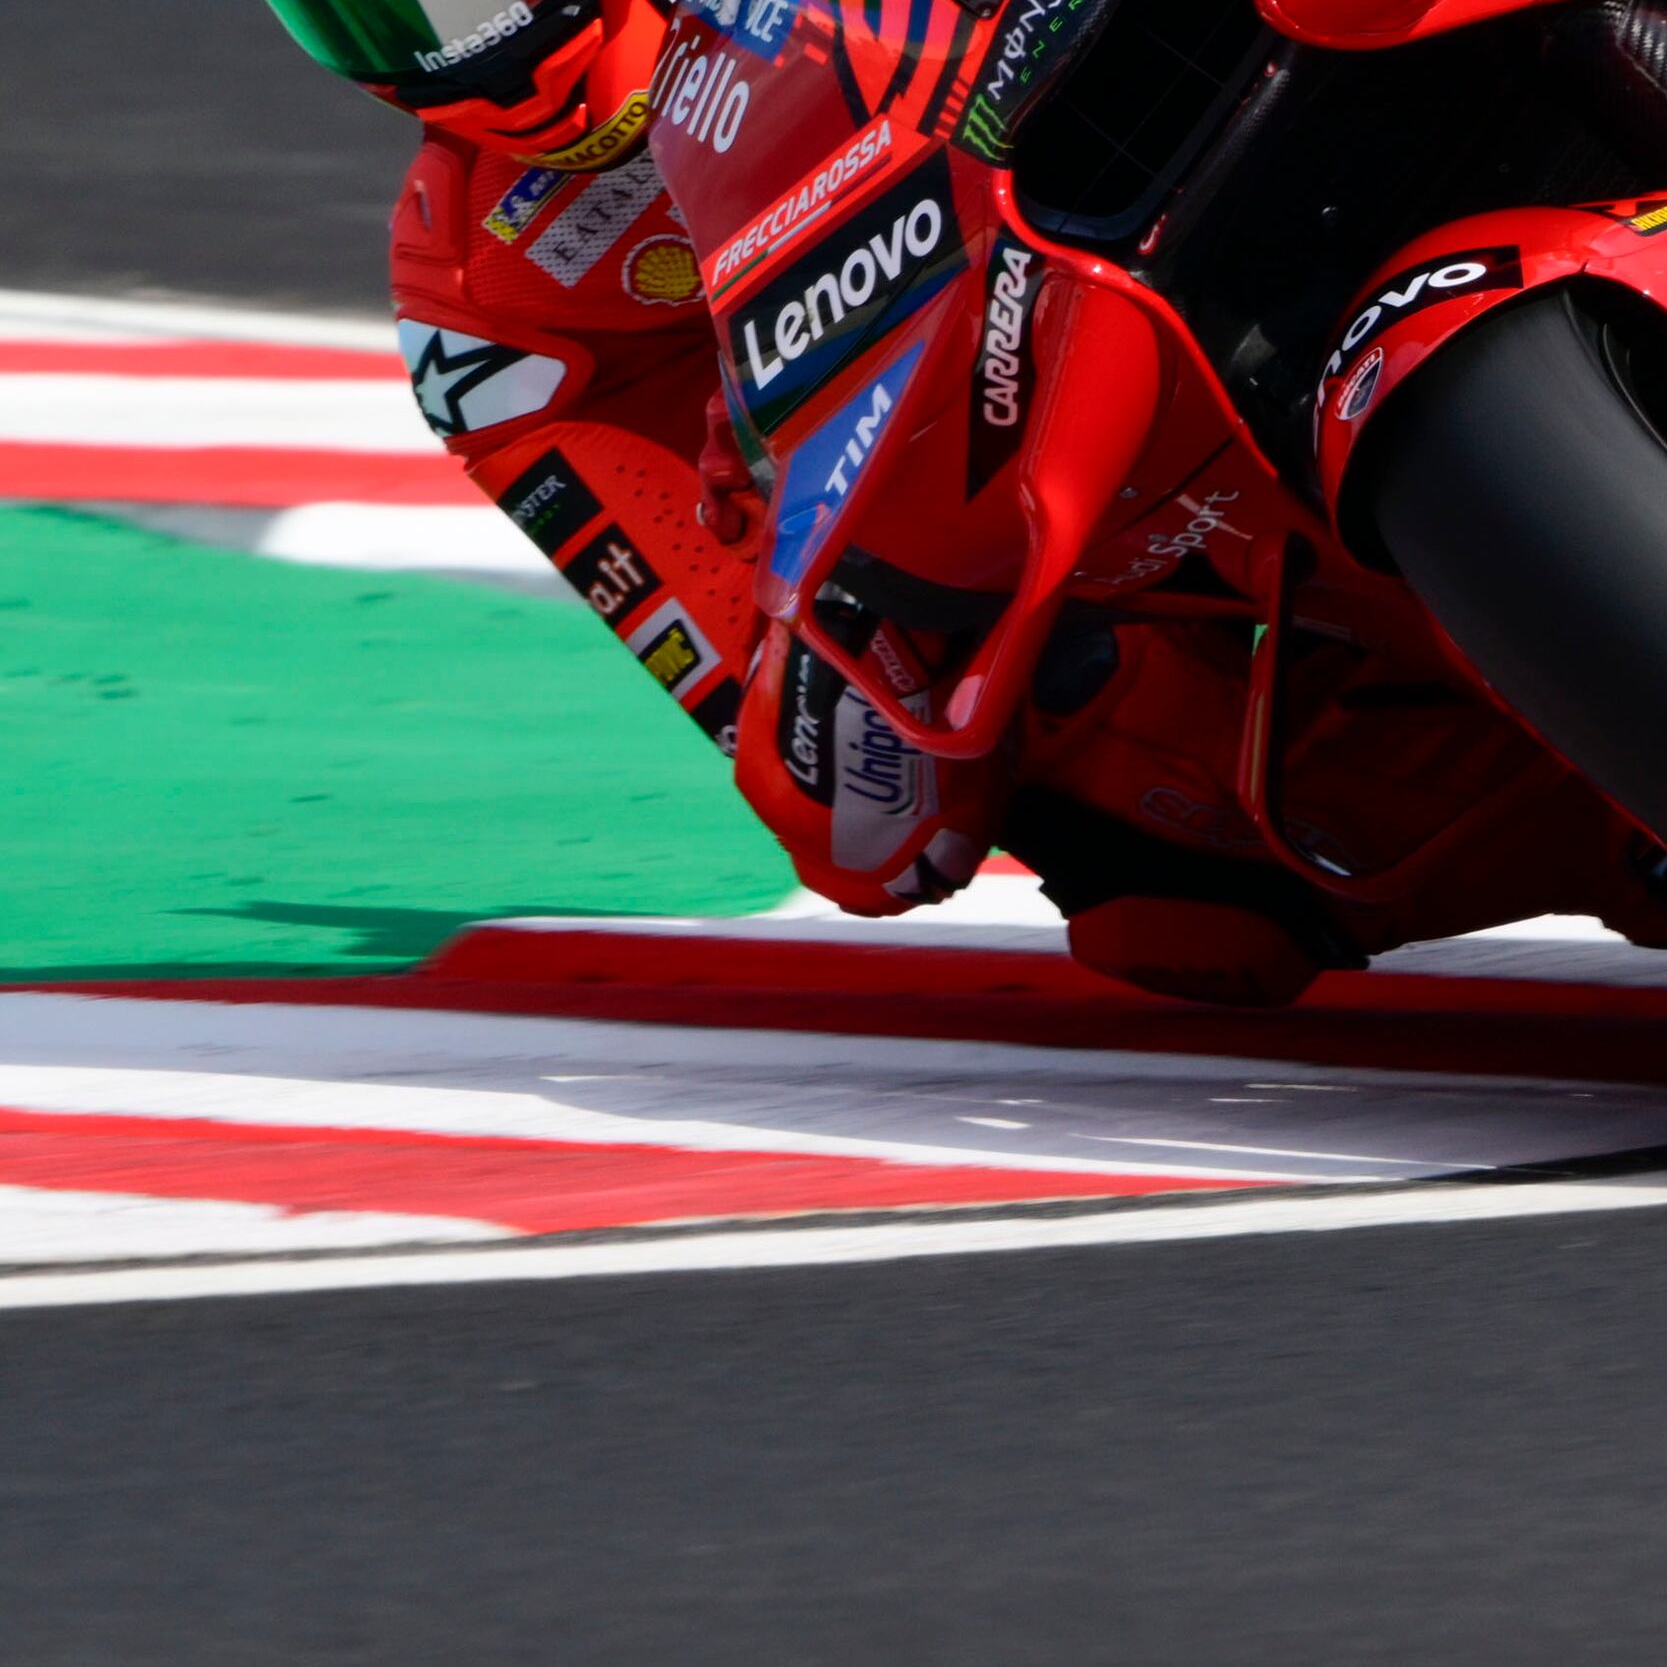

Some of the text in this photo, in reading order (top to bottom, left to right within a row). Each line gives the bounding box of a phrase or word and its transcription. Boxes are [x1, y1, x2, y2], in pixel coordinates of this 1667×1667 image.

[413, 0, 534, 73] Insta360
[711, 119, 893, 287] FRECCIAROSSA
[743, 198, 943, 392] Lenovo
[983, 246, 1033, 427] CARRERA
[1314, 261, 1488, 418] novo
[824, 383, 893, 496] TIM
